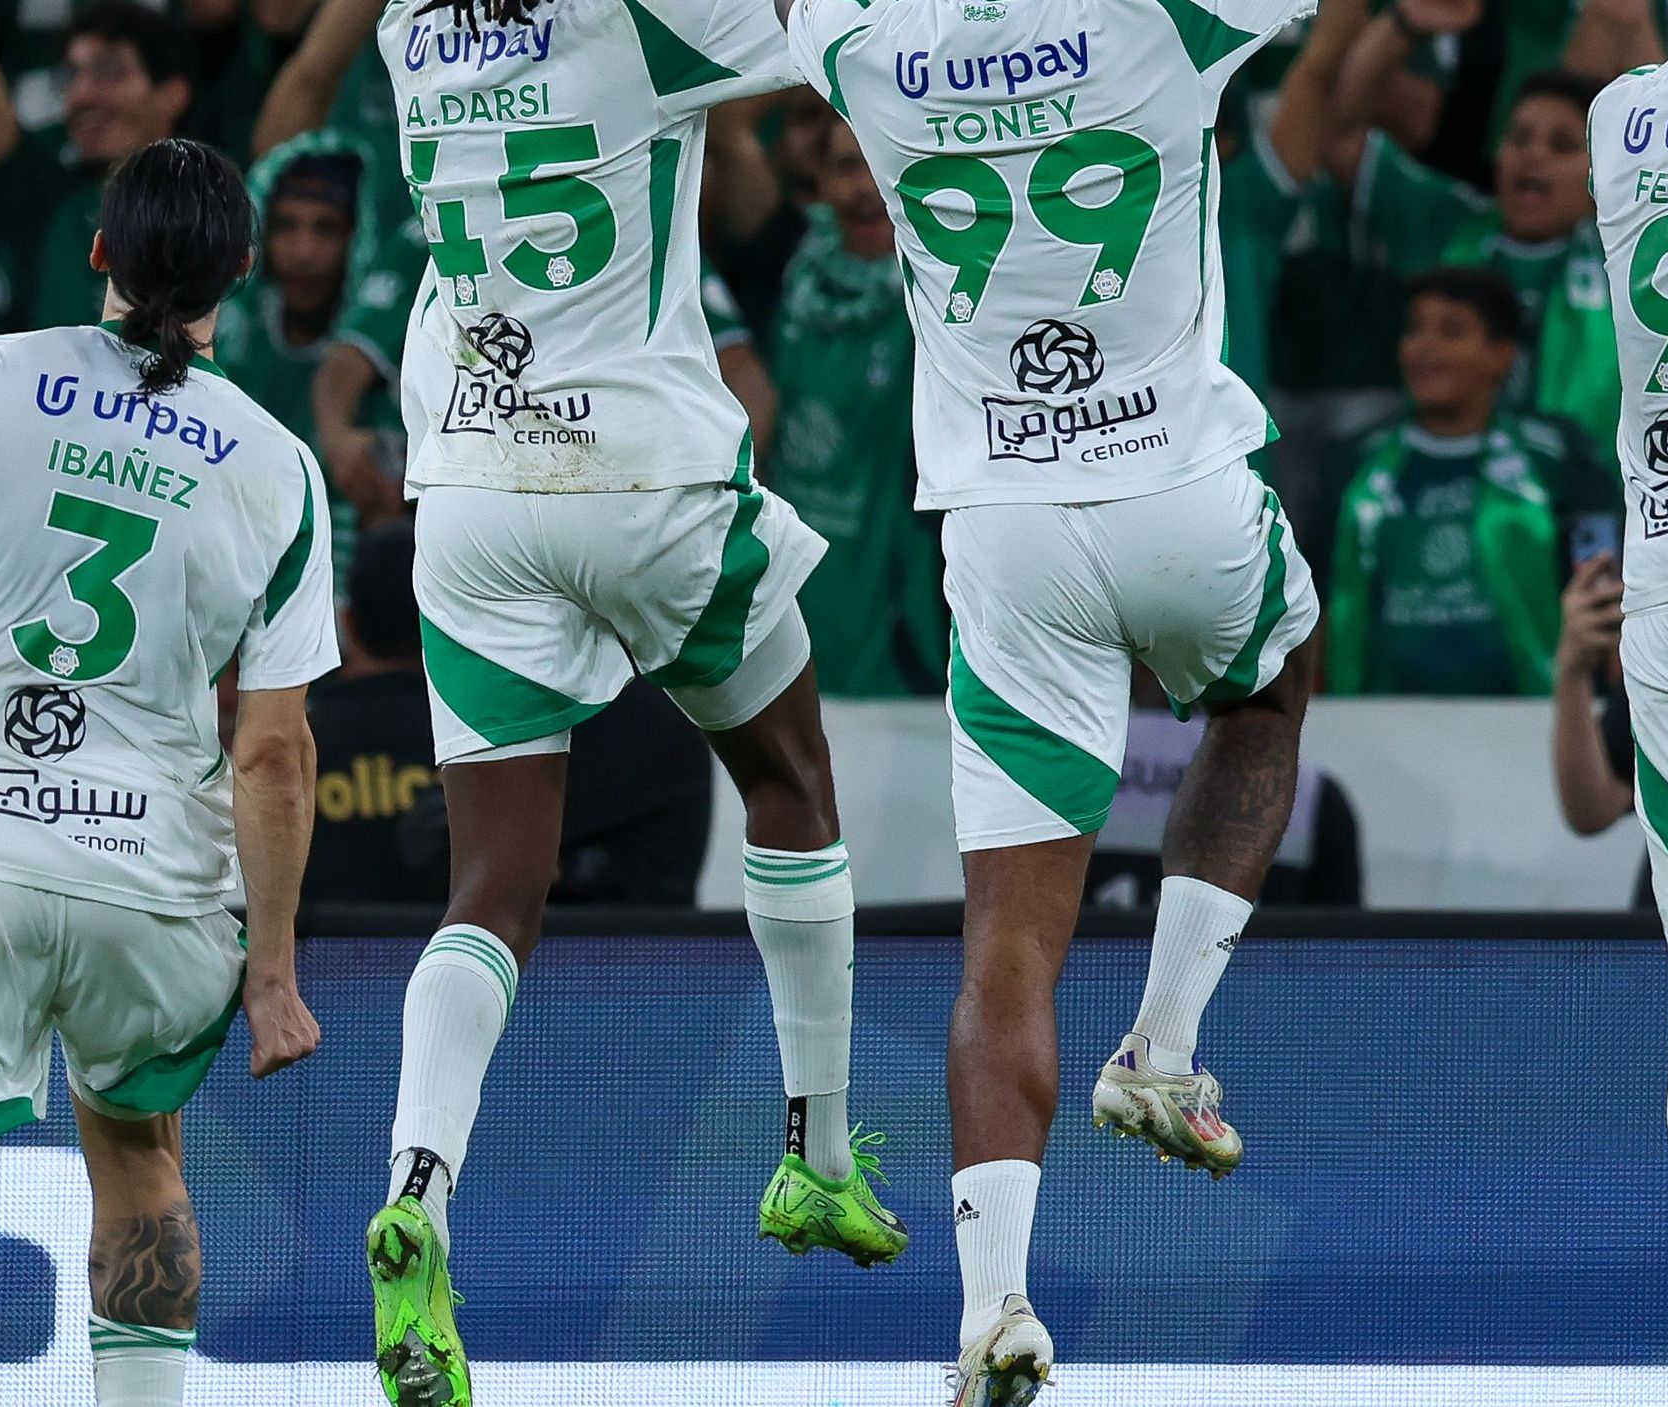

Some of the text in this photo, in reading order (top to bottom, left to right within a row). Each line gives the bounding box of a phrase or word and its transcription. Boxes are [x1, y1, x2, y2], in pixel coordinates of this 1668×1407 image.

[436, 17, 553, 71] urpay
[946, 30, 1090, 95] urpay
[406, 83, 551, 128] A.DARSI
[926, 94, 1078, 147] TONEY
[407, 123, 618, 309] 45
[895, 128, 1163, 326] 99
[92, 389, 239, 465] urpay
[996, 385, 1158, 452] سينومي
[47, 438, 200, 510] IBAÑEZ
[8, 489, 161, 682] 3
